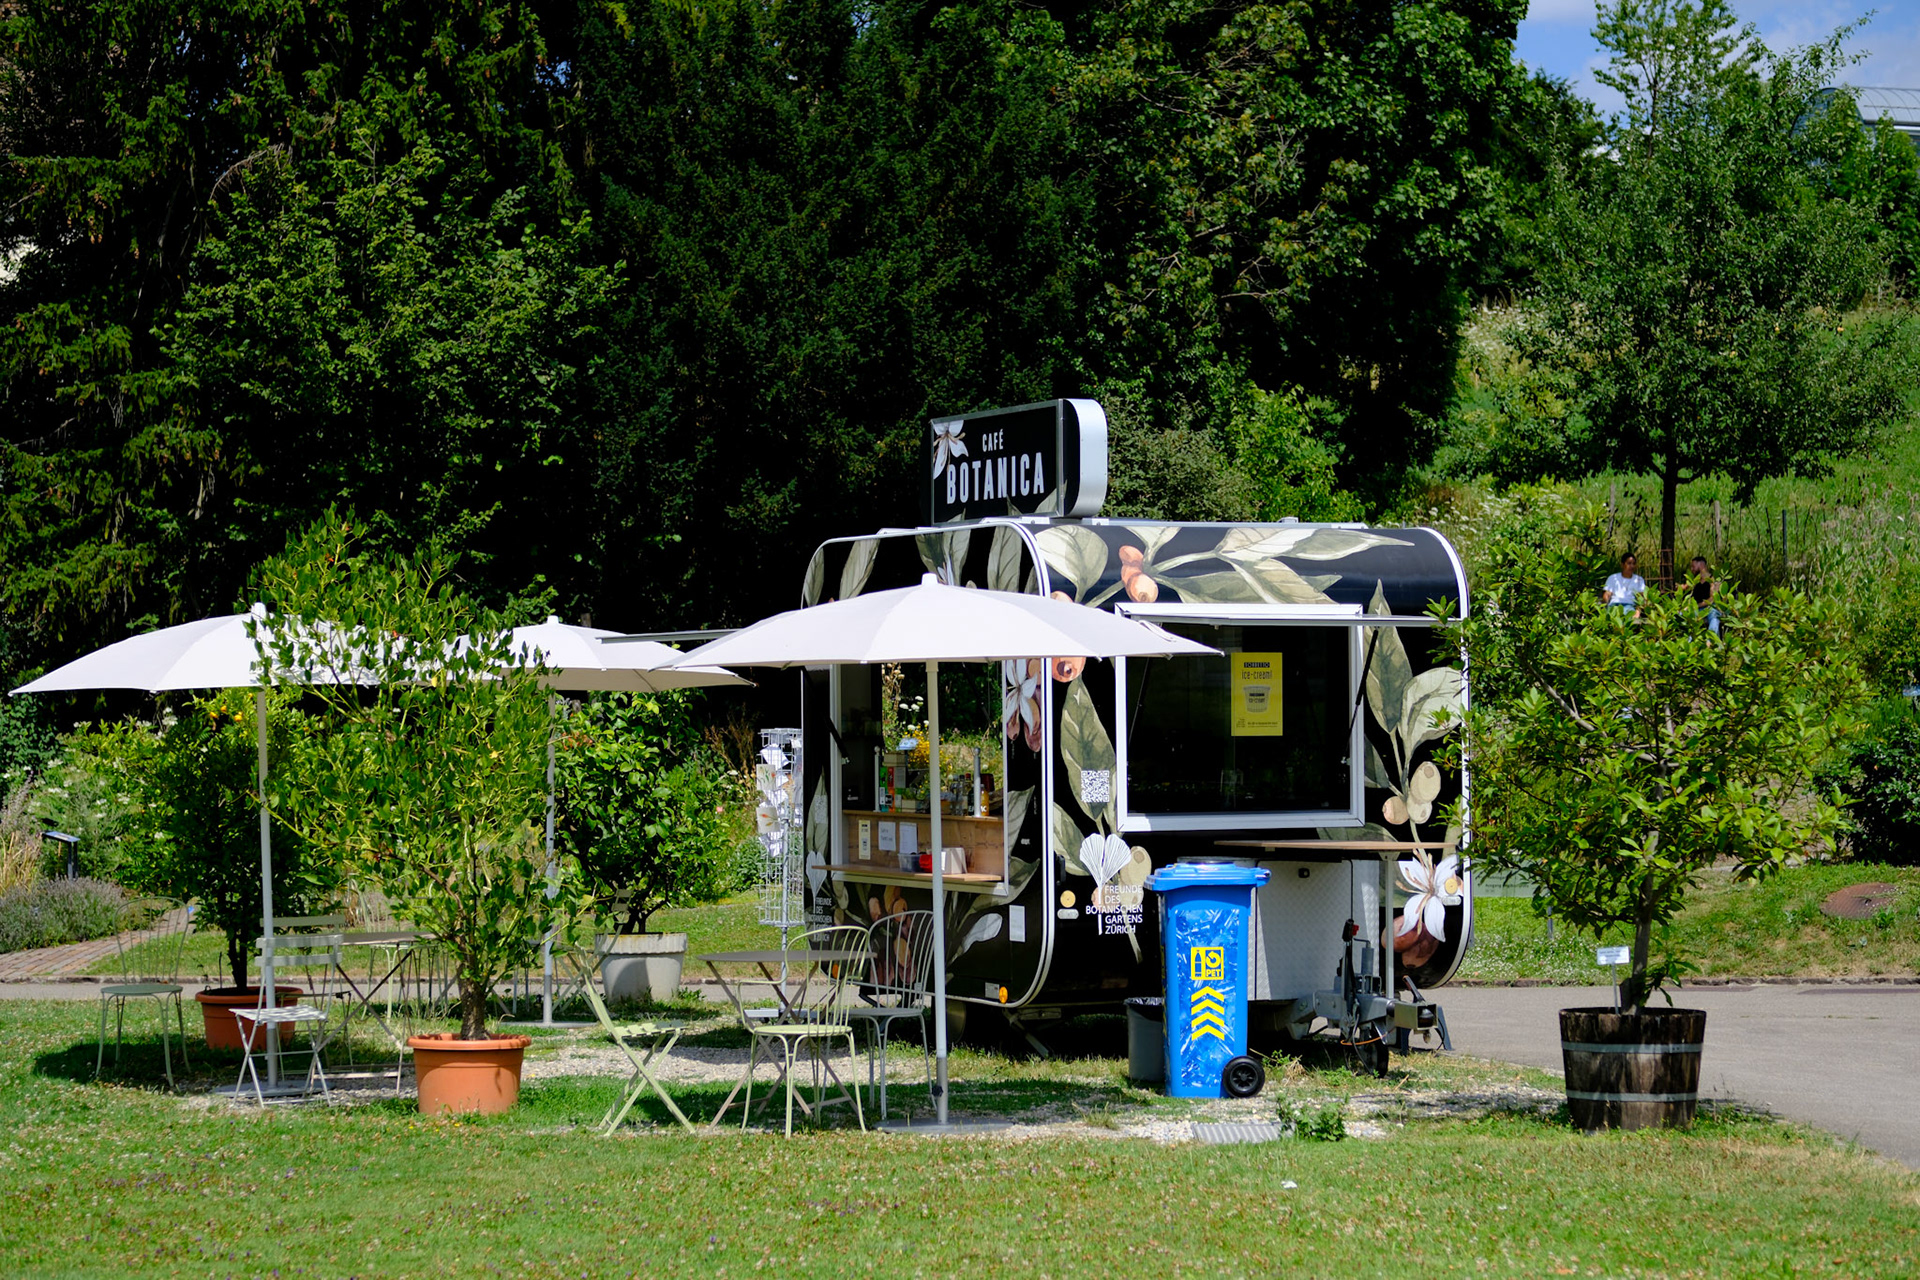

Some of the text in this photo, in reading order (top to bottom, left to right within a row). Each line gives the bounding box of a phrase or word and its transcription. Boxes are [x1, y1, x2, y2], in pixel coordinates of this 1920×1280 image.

[982, 429, 1004, 452] CAFÉ
[946, 452, 1045, 505] BOTANICA
[1104, 885, 1143, 894] FREUNDE
[1104, 894, 1121, 904] DES
[1085, 904, 1143, 915] BOTANISCHEN
[1105, 914, 1143, 924] GARTENS
[1105, 923, 1136, 935] ZÜRICH
[1206, 969, 1221, 977] PET
